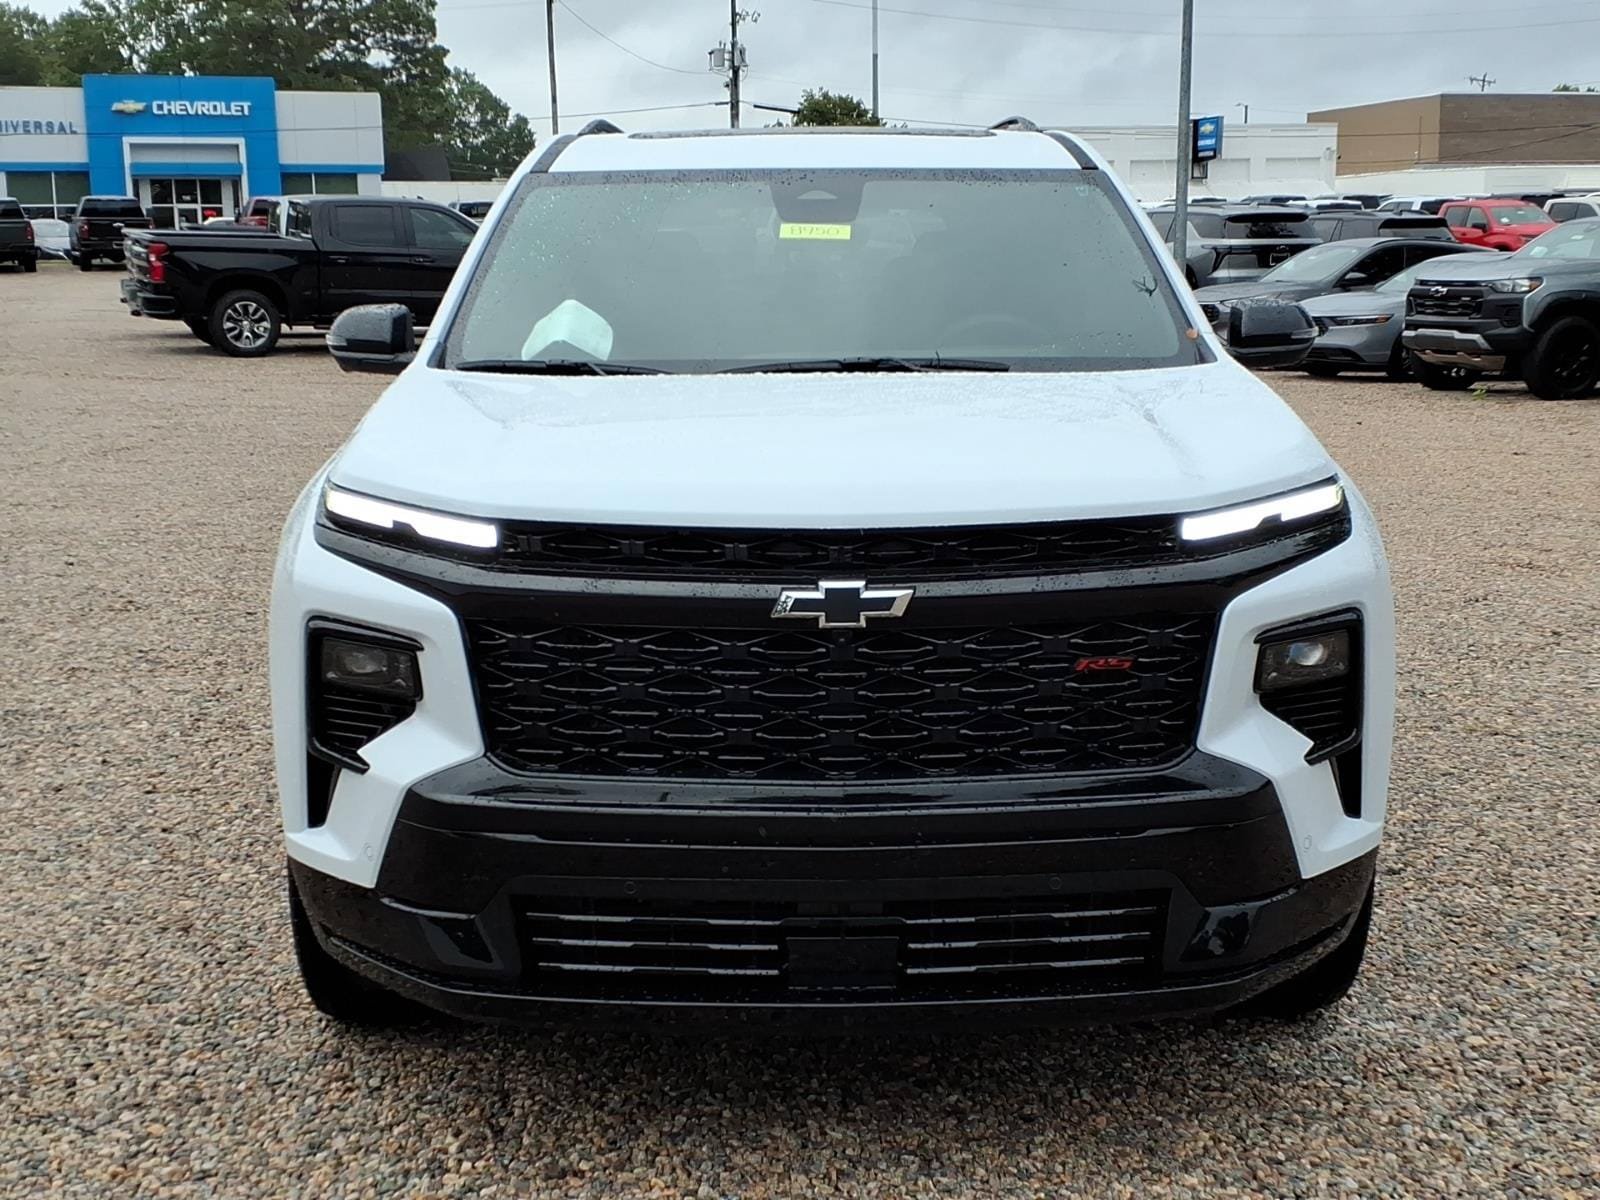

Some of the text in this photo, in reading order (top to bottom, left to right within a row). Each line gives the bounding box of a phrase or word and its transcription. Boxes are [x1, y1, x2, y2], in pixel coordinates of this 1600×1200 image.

[152, 100, 252, 116] CHEVROLET
[0, 119, 78, 135] IVERSAL
[1074, 656, 1135, 671] RS
